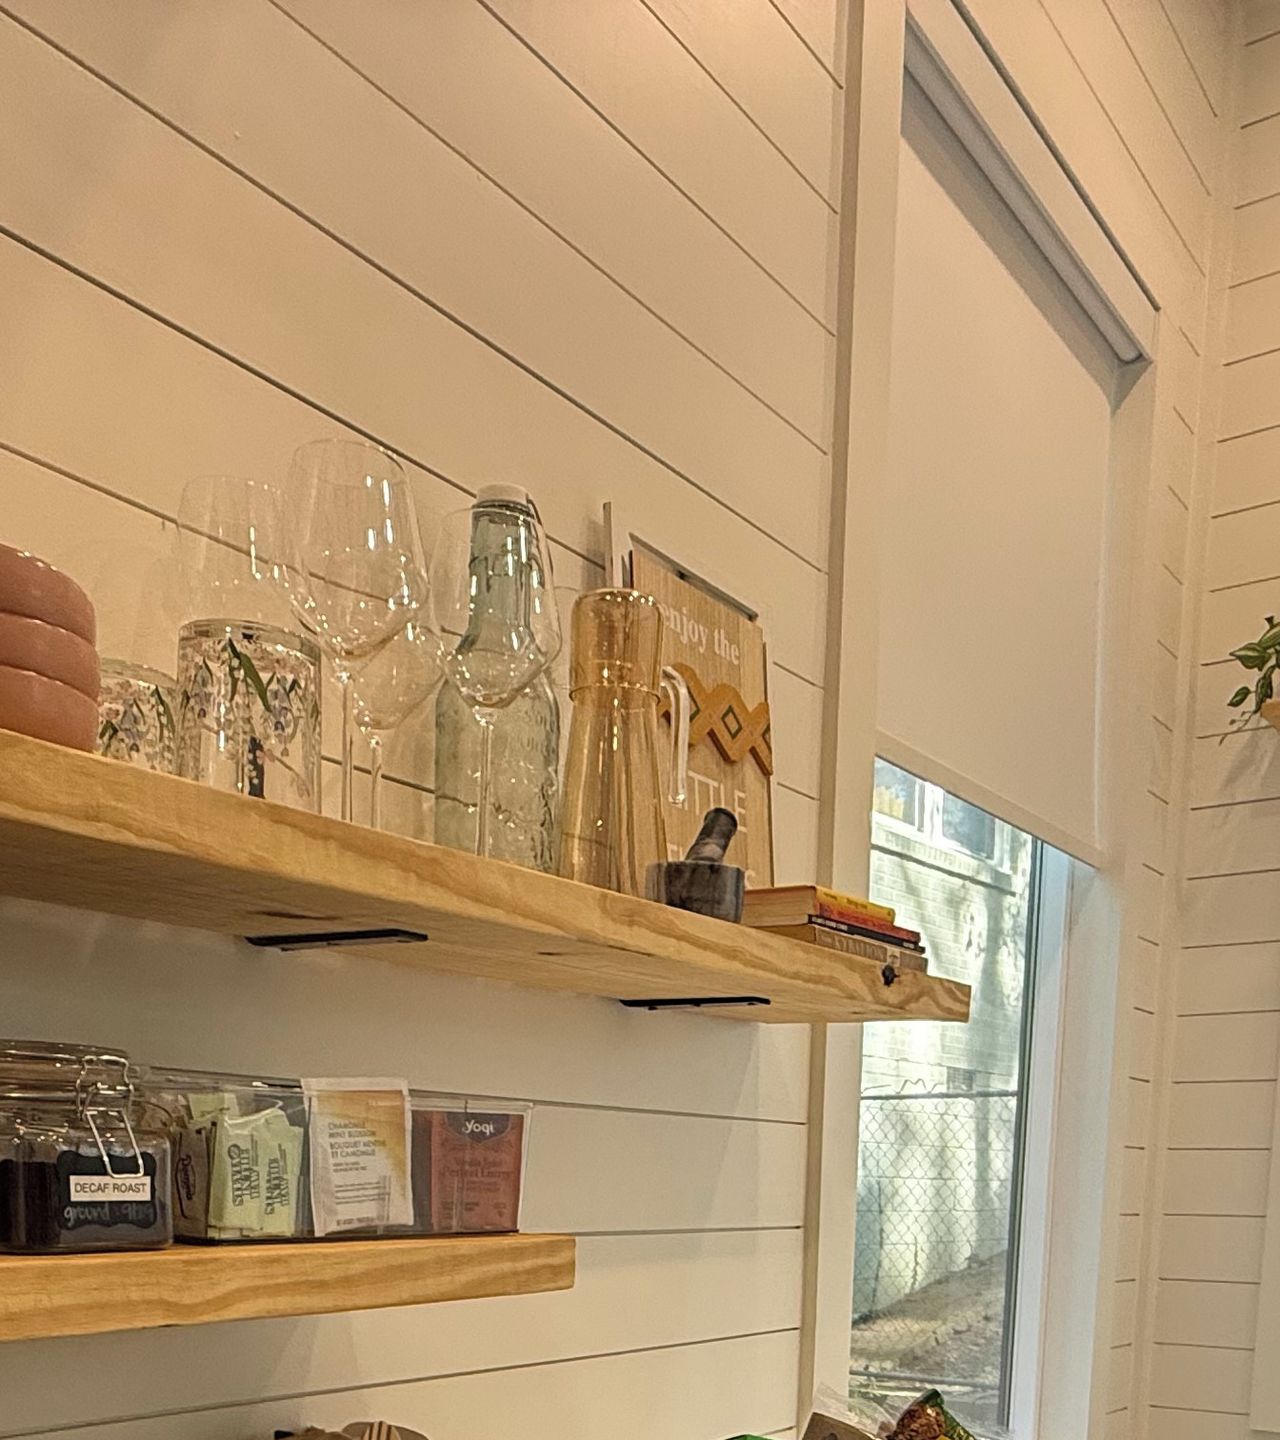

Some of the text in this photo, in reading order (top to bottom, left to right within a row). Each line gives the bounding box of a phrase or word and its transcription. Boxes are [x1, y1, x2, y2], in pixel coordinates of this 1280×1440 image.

[661, 604, 739, 665] enjoy the
[74, 1183, 147, 1194] DECAF ROAST
